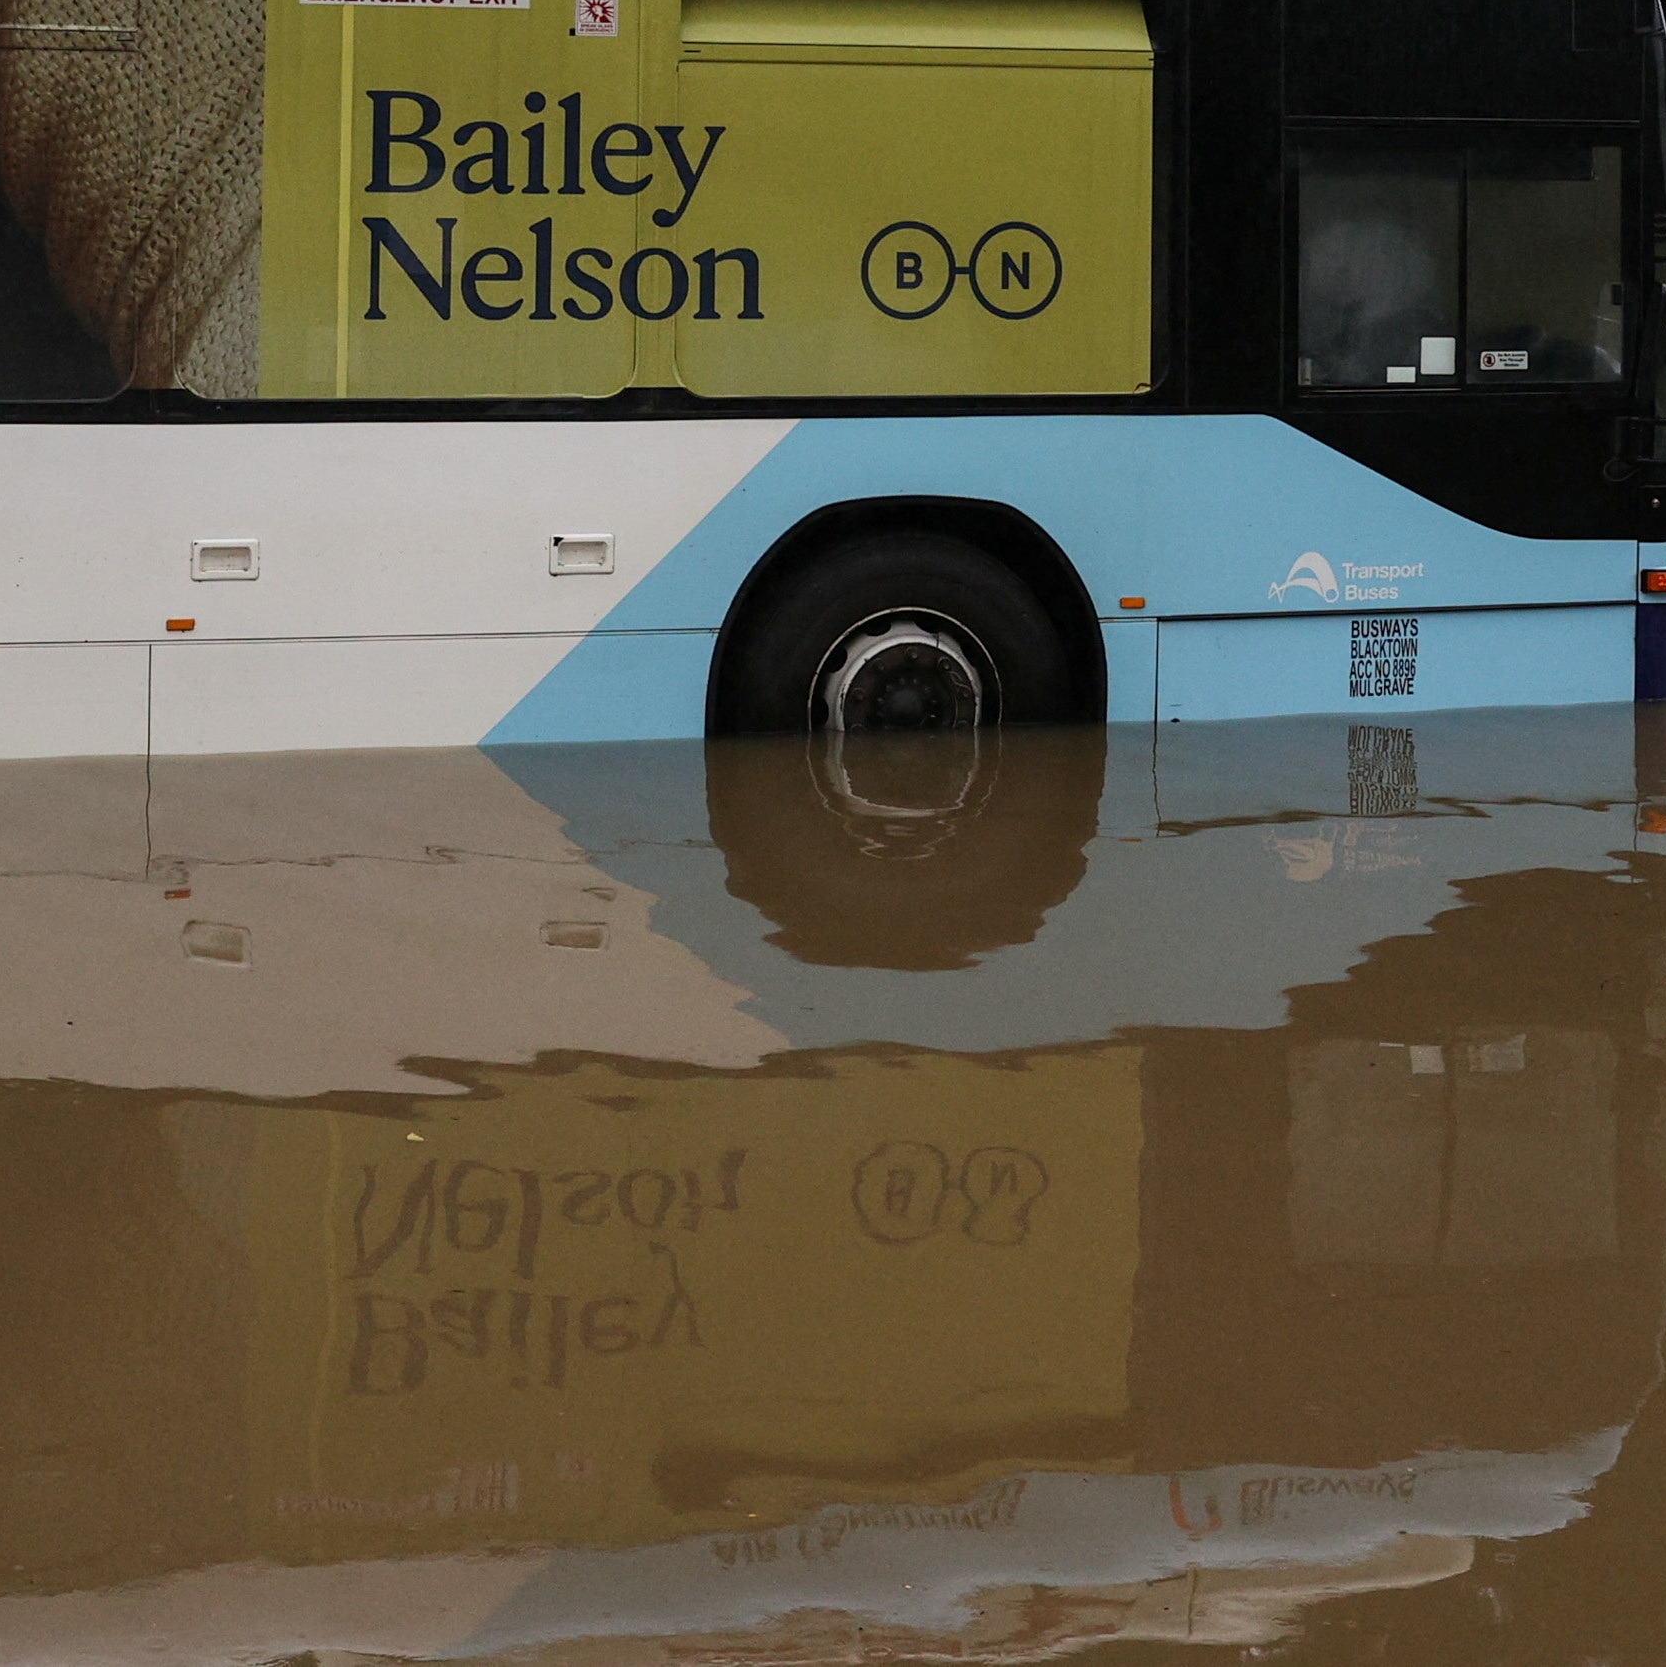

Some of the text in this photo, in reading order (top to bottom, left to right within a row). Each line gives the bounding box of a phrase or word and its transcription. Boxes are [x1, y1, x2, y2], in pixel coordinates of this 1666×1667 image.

[364, 90, 727, 227] Bailey
[361, 217, 765, 321] Nelson
[896, 252, 1030, 289] B N
[1342, 562, 1425, 581] Transport
[1345, 585, 1399, 601] Buses
[1351, 618, 1418, 638] BUSWAYS
[1350, 638, 1418, 659] BLACKTOWN
[1349, 658, 1416, 679] ACC NO 8896
[1349, 677, 1414, 697] MULGRAVE
